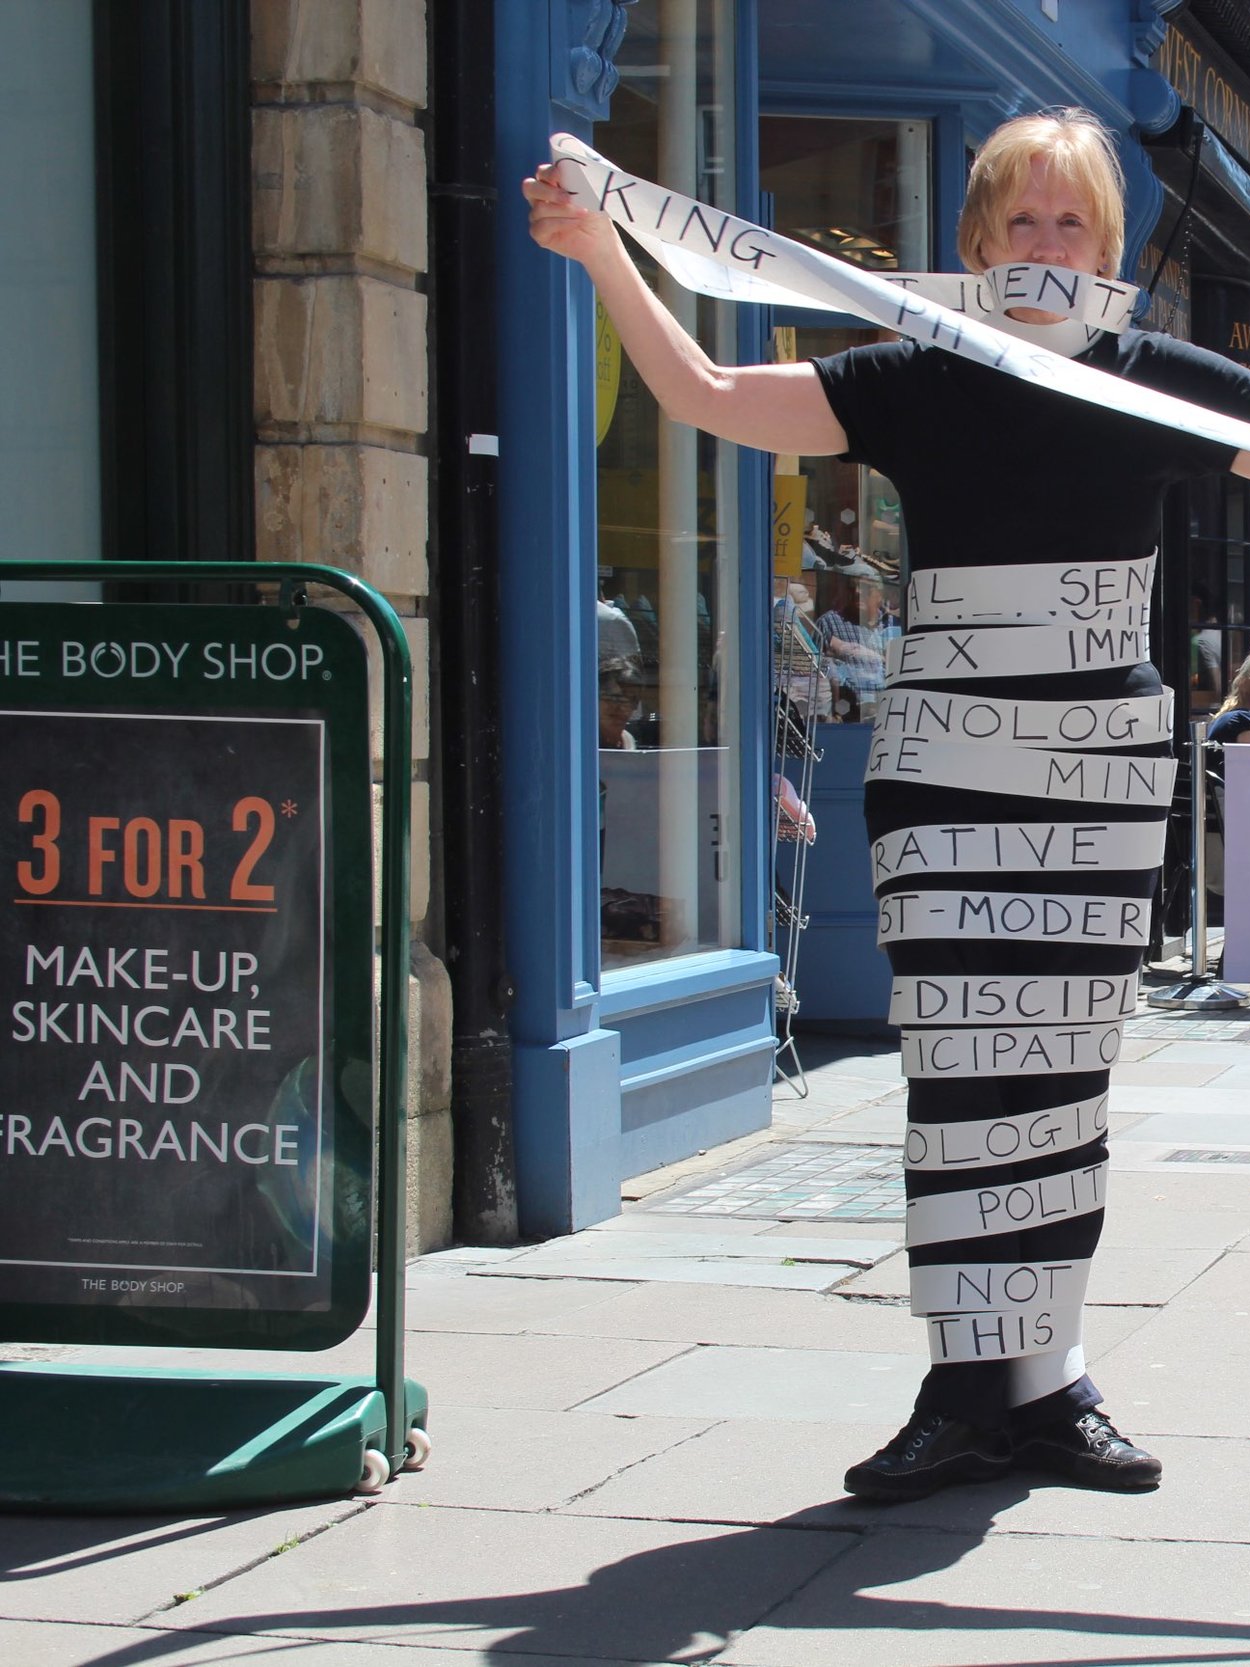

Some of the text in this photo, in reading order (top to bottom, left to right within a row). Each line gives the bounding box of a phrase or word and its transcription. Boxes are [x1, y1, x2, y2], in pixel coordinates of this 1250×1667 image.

[62, 640, 190, 679] BODY
[17, 788, 62, 896] 3
[88, 815, 207, 899] FOR
[875, 825, 1108, 880] RATIVE
[25, 944, 260, 1000] MAKE-UP,
[12, 1001, 272, 1051] SKINCARE
[902, 1027, 1121, 1072] ICIPATO
[78, 1060, 201, 1105] AND
[0, 1113, 300, 1167] RAGRANCE
[978, 1164, 1102, 1230] POLIT
[81, 1278, 107, 1291] THE
[111, 1279, 148, 1292] BODY
[956, 1266, 1072, 1305] NOT
[932, 1312, 1053, 1358] THIS
